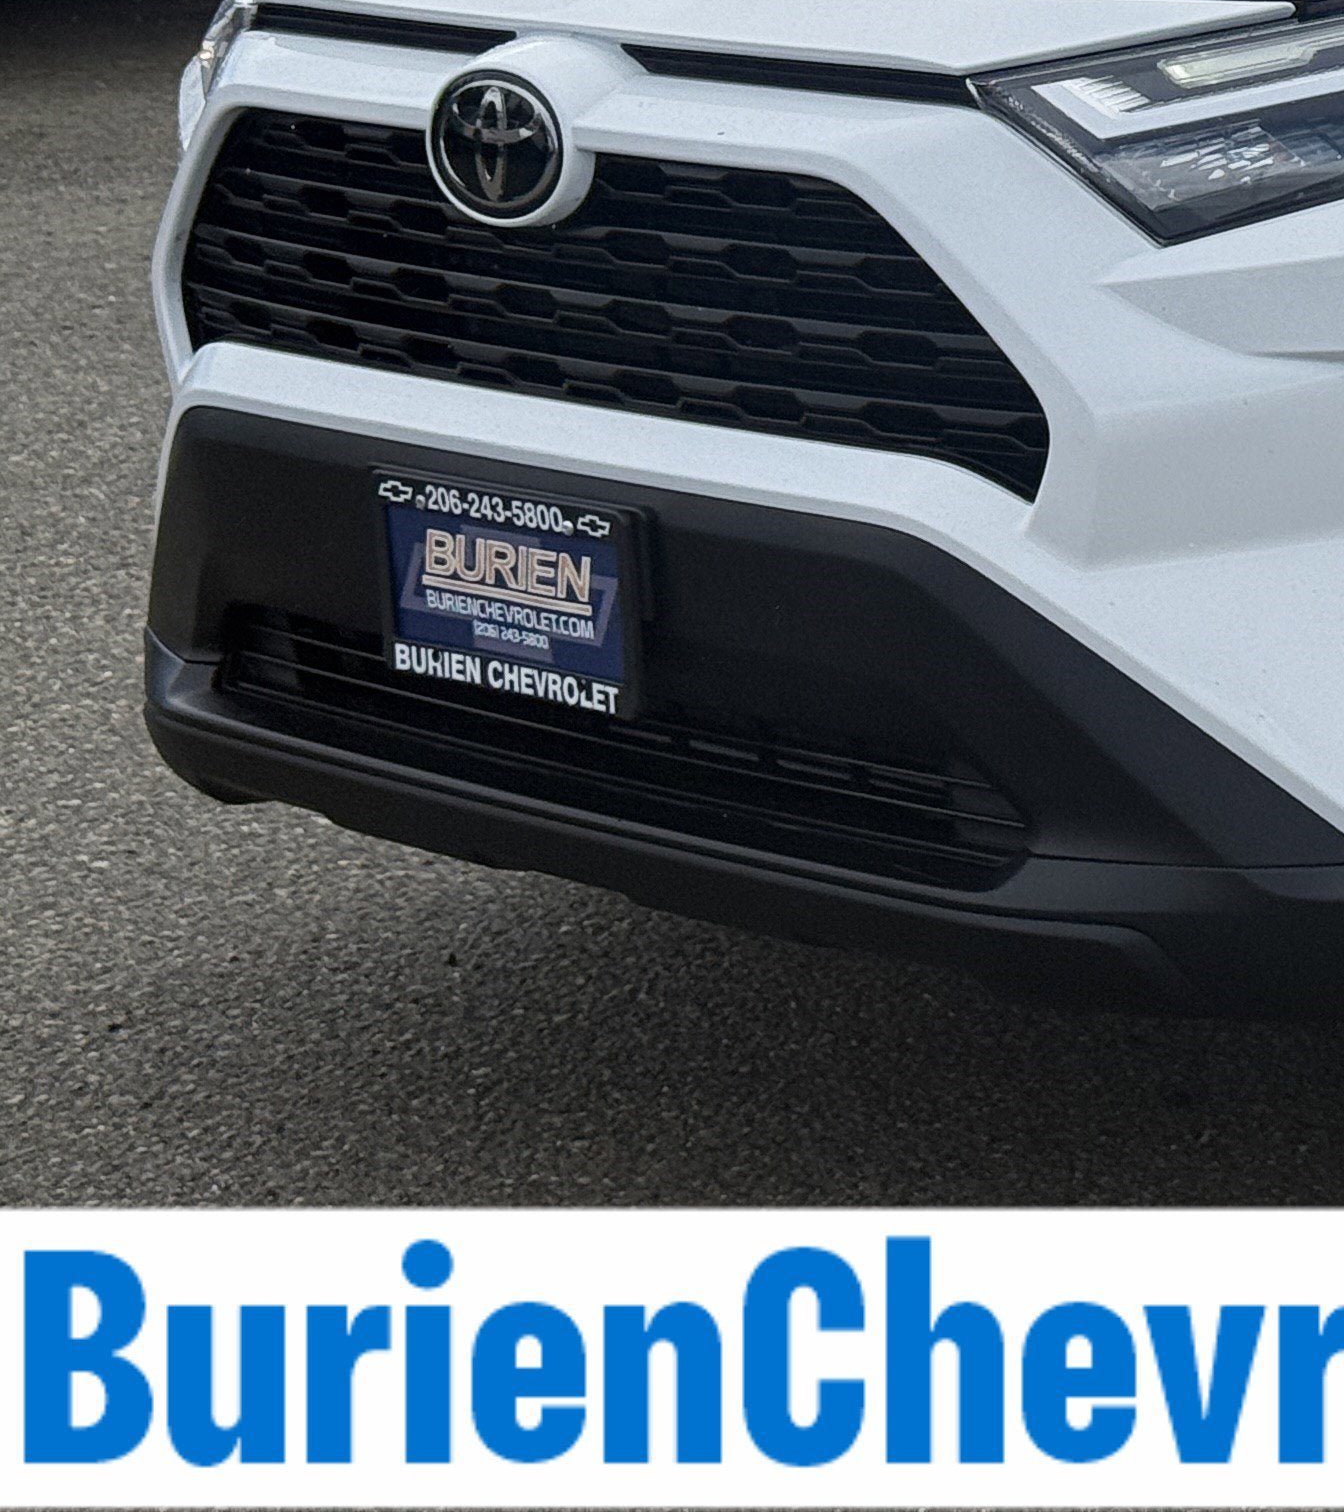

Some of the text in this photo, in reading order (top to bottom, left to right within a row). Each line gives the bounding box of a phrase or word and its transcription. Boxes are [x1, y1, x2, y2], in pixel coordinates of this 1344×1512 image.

[425, 484, 563, 533] 206-243-5800
[425, 528, 592, 602] BURIEN
[425, 588, 595, 640] BURIENCHEVROLET.COM
[394, 642, 481, 685] BURIEN
